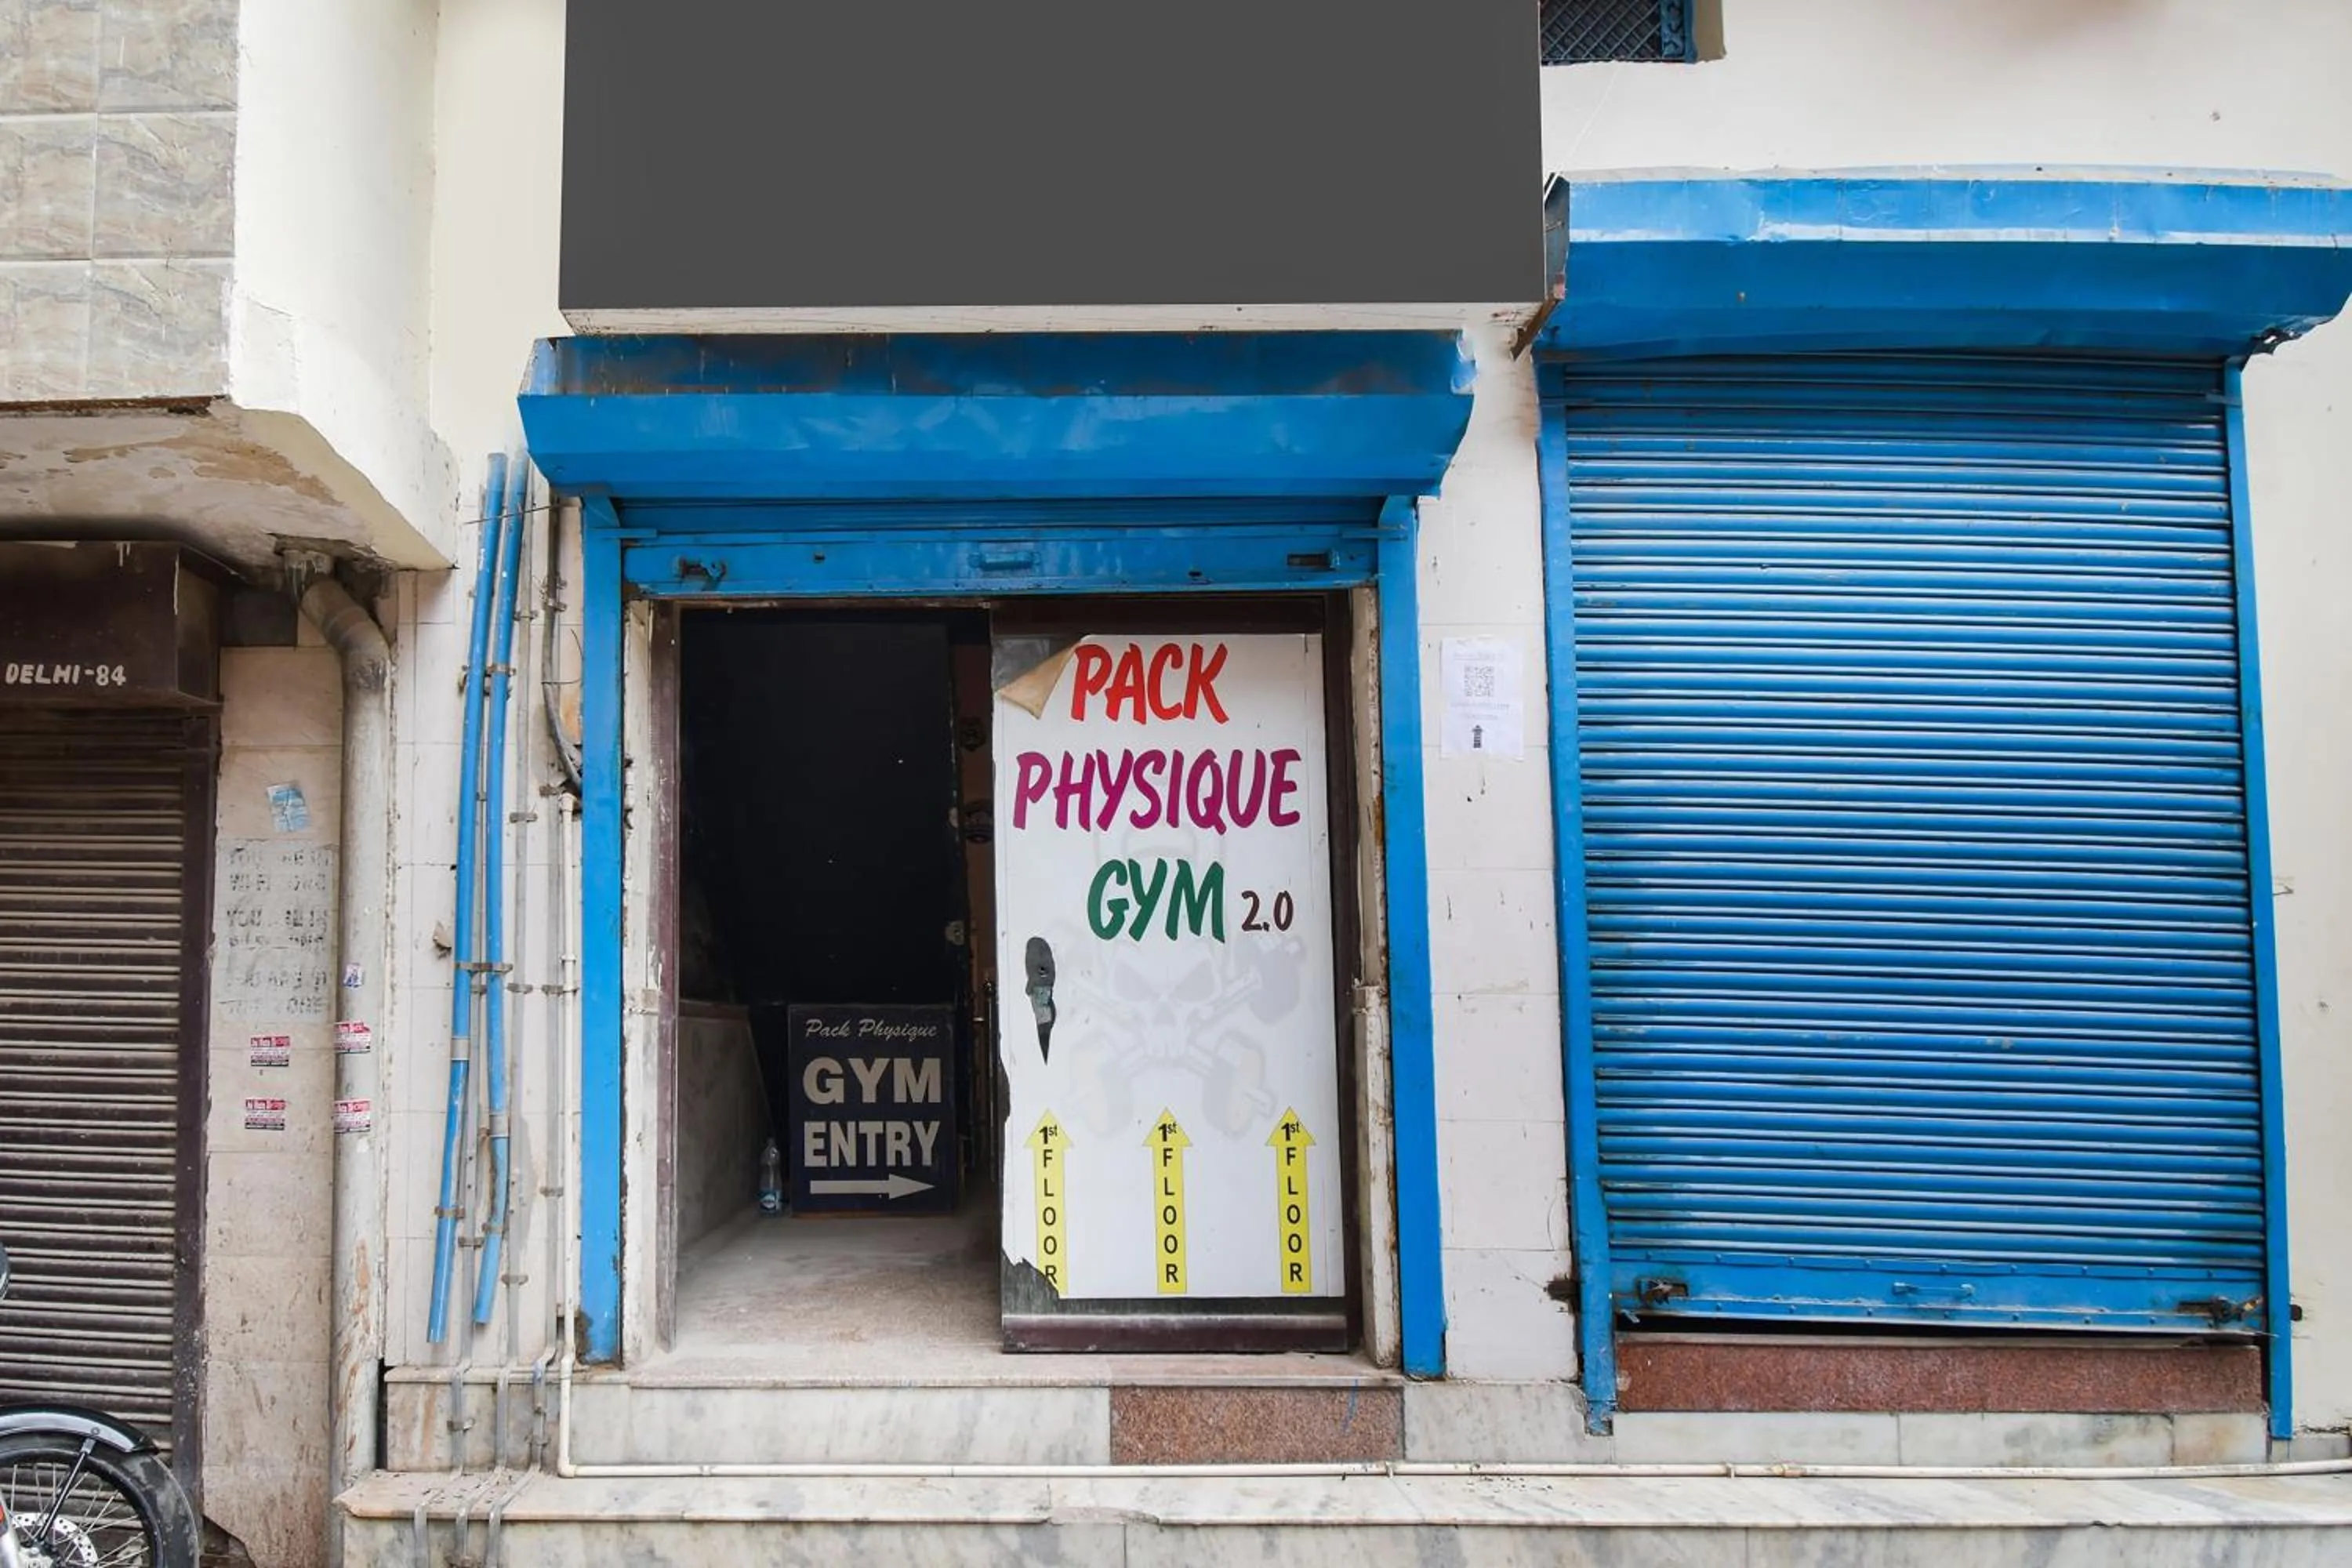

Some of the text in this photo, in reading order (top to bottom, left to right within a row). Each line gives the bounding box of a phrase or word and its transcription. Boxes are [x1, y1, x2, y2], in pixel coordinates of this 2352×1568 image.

[5, 662, 126, 686] DELHI-84
[1071, 642, 1229, 724] PACK
[1013, 749, 1301, 835] PHYSIQUE
[1087, 858, 1294, 943] GYM 2.0
[805, 1018, 938, 1042] Pack Physique
[803, 1057, 942, 1105] GYM
[804, 1120, 940, 1167] ENTRY
[1039, 1126, 1058, 1284] 1st FLOOR
[1157, 1123, 1178, 1283] 1st FLOOR
[1280, 1121, 1303, 1282] 1st FLOOR
